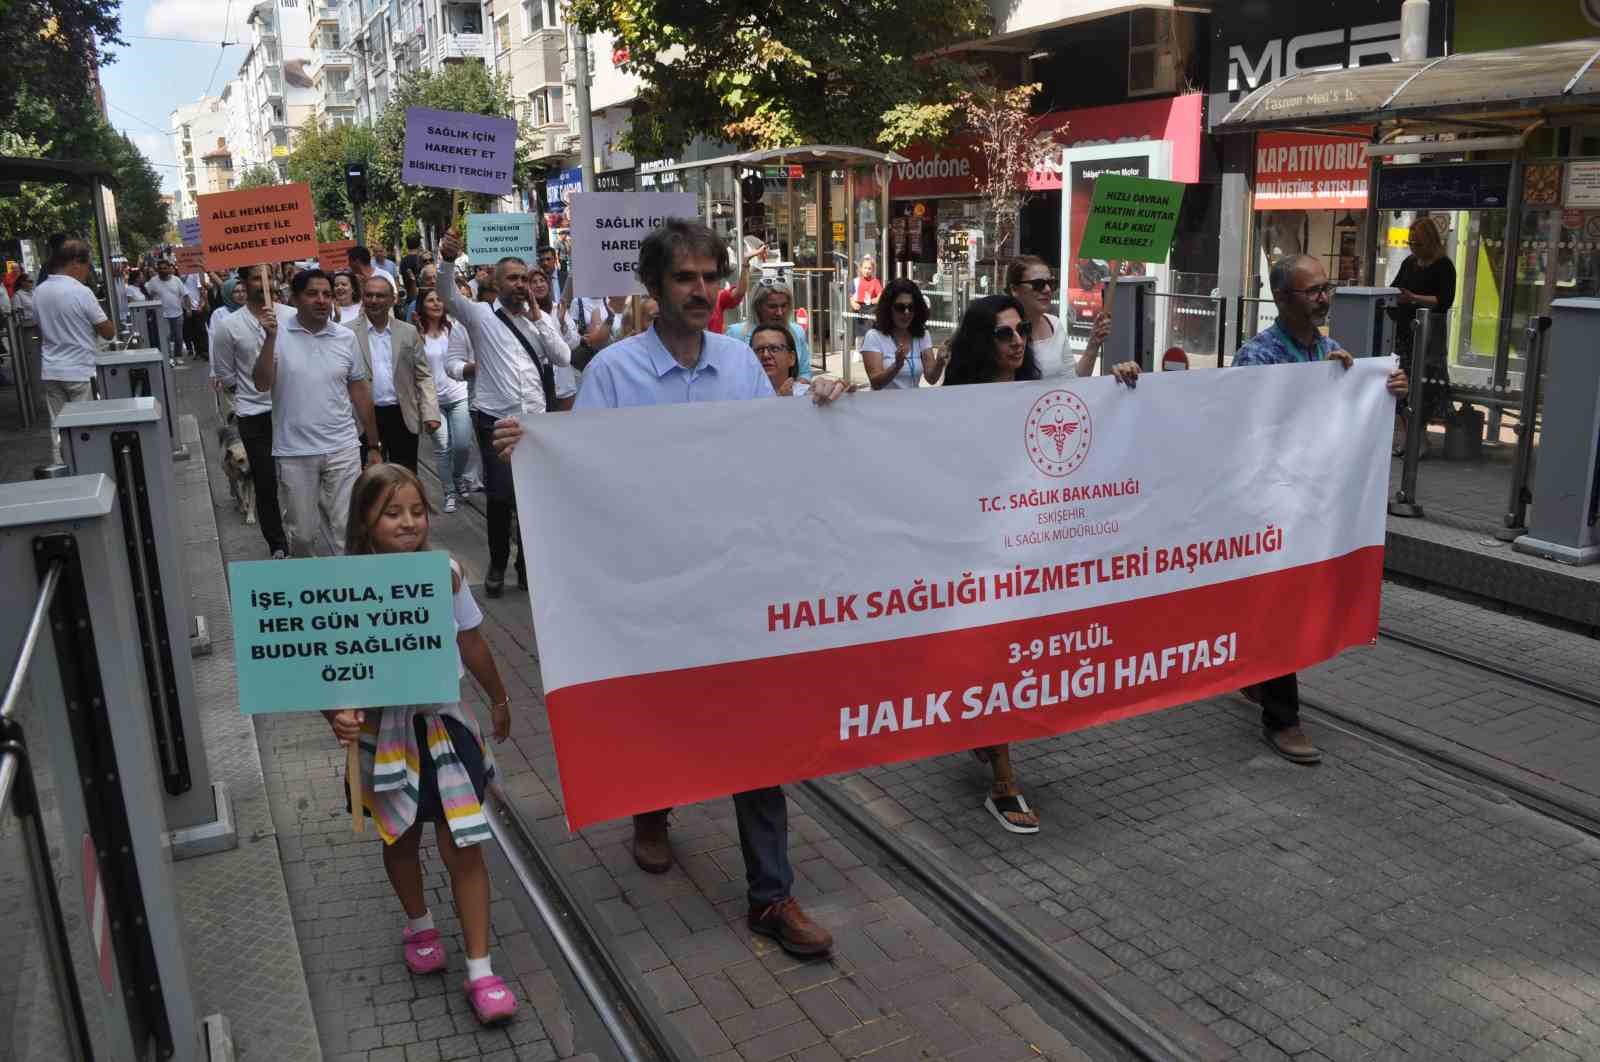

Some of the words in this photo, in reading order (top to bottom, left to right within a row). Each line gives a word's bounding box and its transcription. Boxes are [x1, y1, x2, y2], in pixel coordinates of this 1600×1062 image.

[427, 126, 469, 139] SAĞLIK
[472, 131, 496, 143] İÇİN
[425, 143, 478, 157] HAREKET
[481, 150, 496, 159] ET
[1257, 142, 1368, 173] KAPATIYORUZ
[459, 166, 494, 179] TERCİH
[495, 171, 507, 180] ET
[897, 154, 970, 179] vodafone
[1105, 192, 1132, 201] HIZLI
[1134, 194, 1170, 206] DAVRAN
[1317, 179, 1368, 203] SATIŞLAR
[212, 209, 236, 220] AİLE
[240, 200, 299, 217] HEKİMLERİ
[1094, 206, 1136, 217] HAYATINI
[1137, 209, 1175, 221] KURTAR
[274, 218, 291, 229] İLE
[595, 216, 645, 229] SAĞLIK
[648, 215, 670, 229] İÇİ
[1104, 221, 1129, 231] KALP
[271, 233, 311, 245] EDİYOR
[601, 239, 641, 251] HARE
[978, 496, 1006, 513] T.C.
[1010, 489, 1060, 509] SAĞLIK
[1062, 477, 1140, 501] BAKANLIĞI
[1015, 530, 1051, 546] SAĞLIK
[1052, 520, 1120, 541] MÜDÜRLÜĞÜ
[767, 593, 859, 632] HALK
[866, 571, 986, 619] SAĞLIĞI
[993, 546, 1149, 600] HİZMETLERİ
[1155, 524, 1282, 574] BAŞKANLIĞI
[250, 589, 293, 611] İŞE,
[300, 586, 384, 605] OKULA,
[390, 583, 435, 599] EVE
[259, 617, 305, 633] HER
[311, 612, 360, 630] GÜN
[366, 607, 430, 626] YÜRÜ
[251, 641, 329, 660] BUDUR
[335, 633, 442, 656] SAĞLIĞIN
[1007, 638, 1044, 664] 3-9
[1049, 623, 1113, 657] EYLÜL
[321, 663, 375, 682] ÖZÜ!
[838, 690, 952, 742] HALK
[960, 658, 1106, 720] SAĞLIĞI
[1113, 631, 1238, 689] HAFTASI
